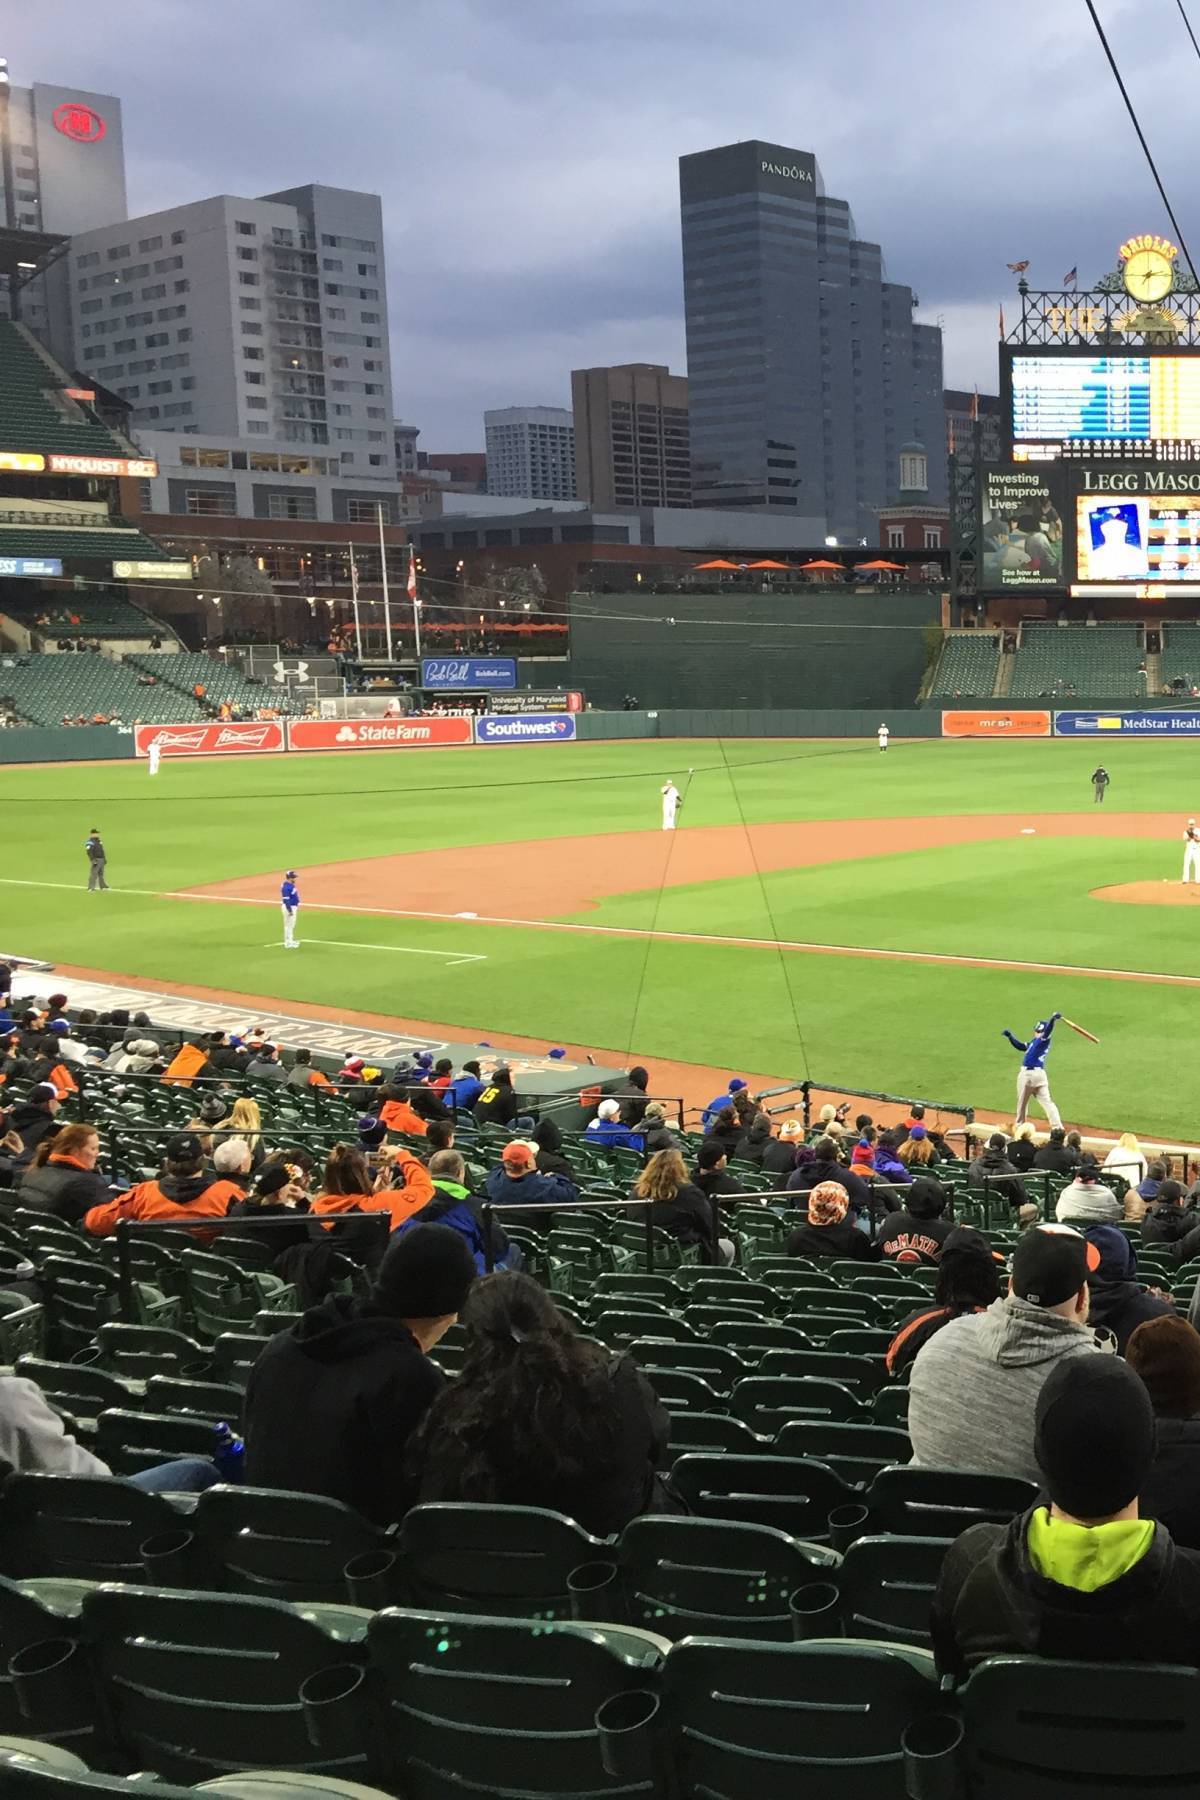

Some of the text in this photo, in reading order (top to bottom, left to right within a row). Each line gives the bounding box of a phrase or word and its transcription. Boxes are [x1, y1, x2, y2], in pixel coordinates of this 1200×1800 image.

[762, 161, 812, 182] PANDORA
[1119, 234, 1178, 261] ORIOLES
[1044, 307, 1105, 332] THE
[988, 473, 1040, 485] Investing
[1084, 471, 1138, 490] LEGG
[988, 486, 1050, 498] to Improve
[492, 696, 526, 705] University
[536, 696, 567, 705] Maryland
[486, 721, 556, 736] Southwest
[1124, 719, 1169, 728] MedStar
[299, 1028, 427, 1058] PARK
